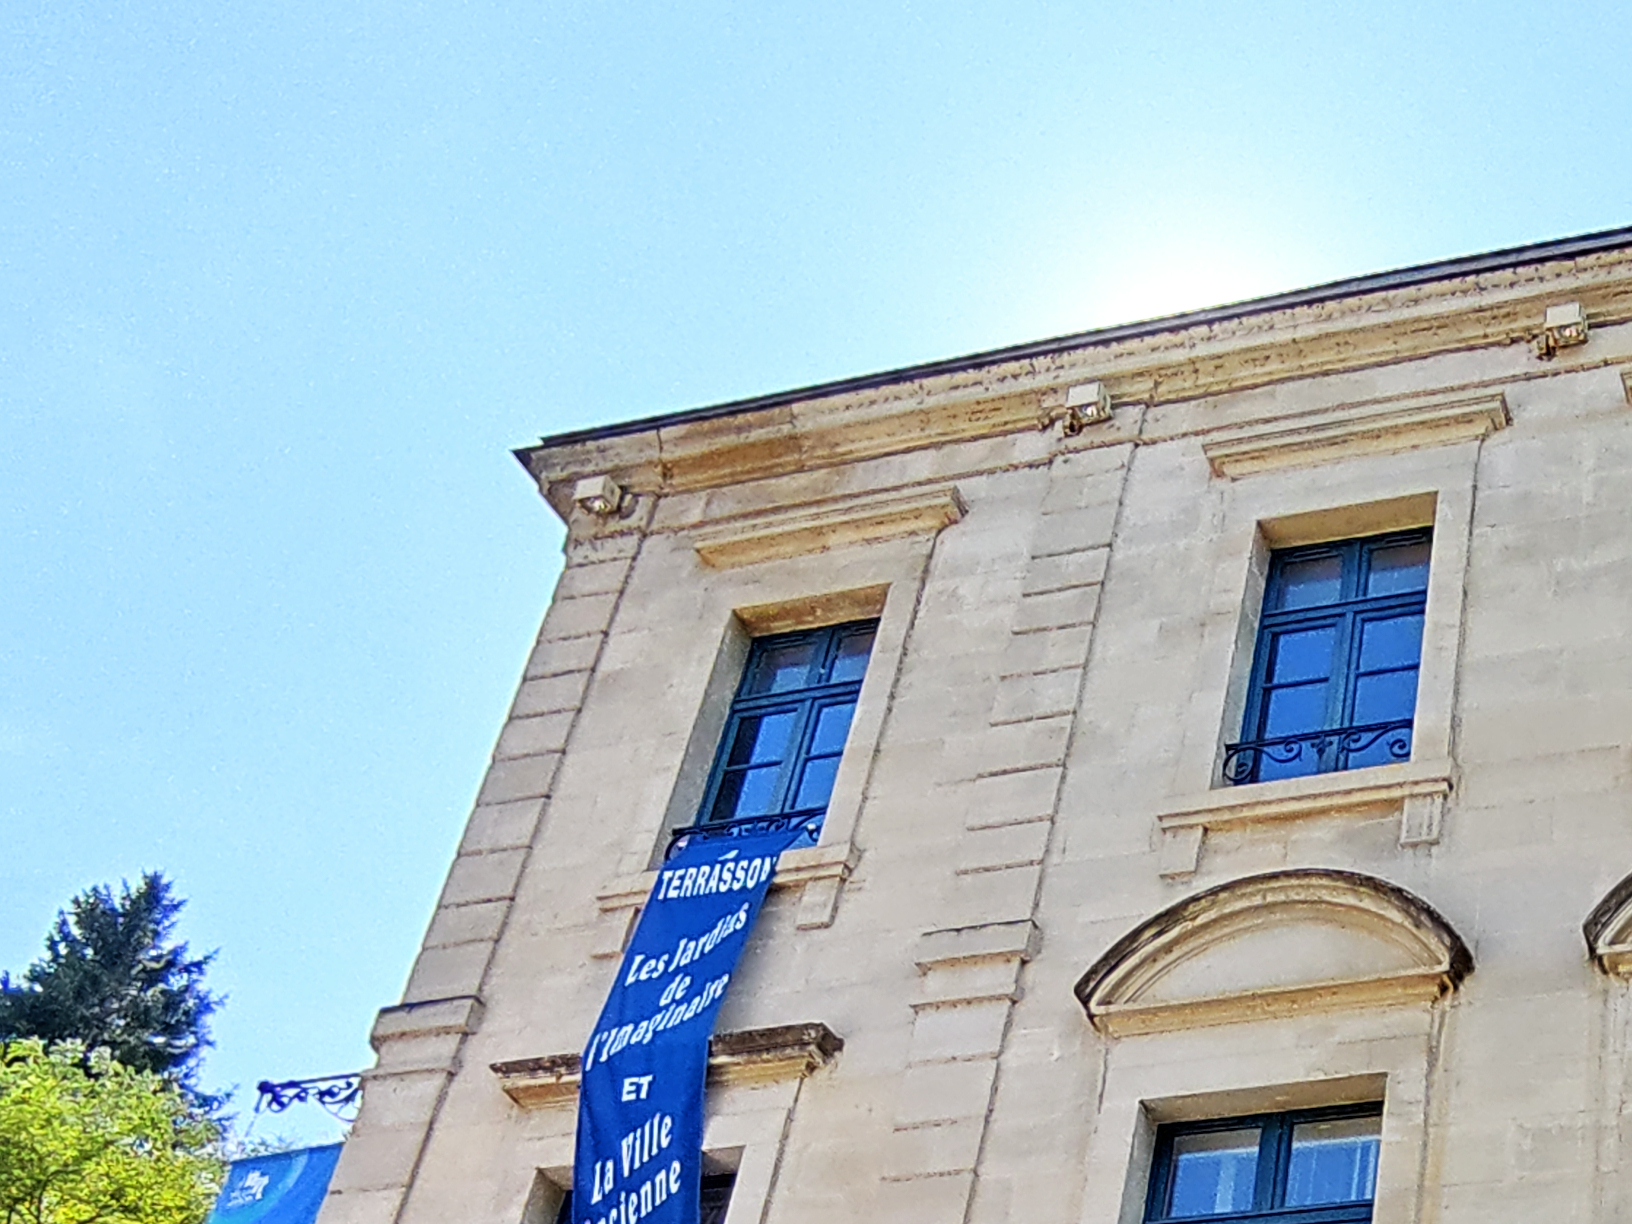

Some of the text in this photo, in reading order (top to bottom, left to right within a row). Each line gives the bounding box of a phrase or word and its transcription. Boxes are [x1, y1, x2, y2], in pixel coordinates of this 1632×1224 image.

[624, 953, 669, 987] Les
[659, 972, 692, 1007] de
[621, 1075, 653, 1102] ET
[591, 1111, 672, 1206] La Ville
